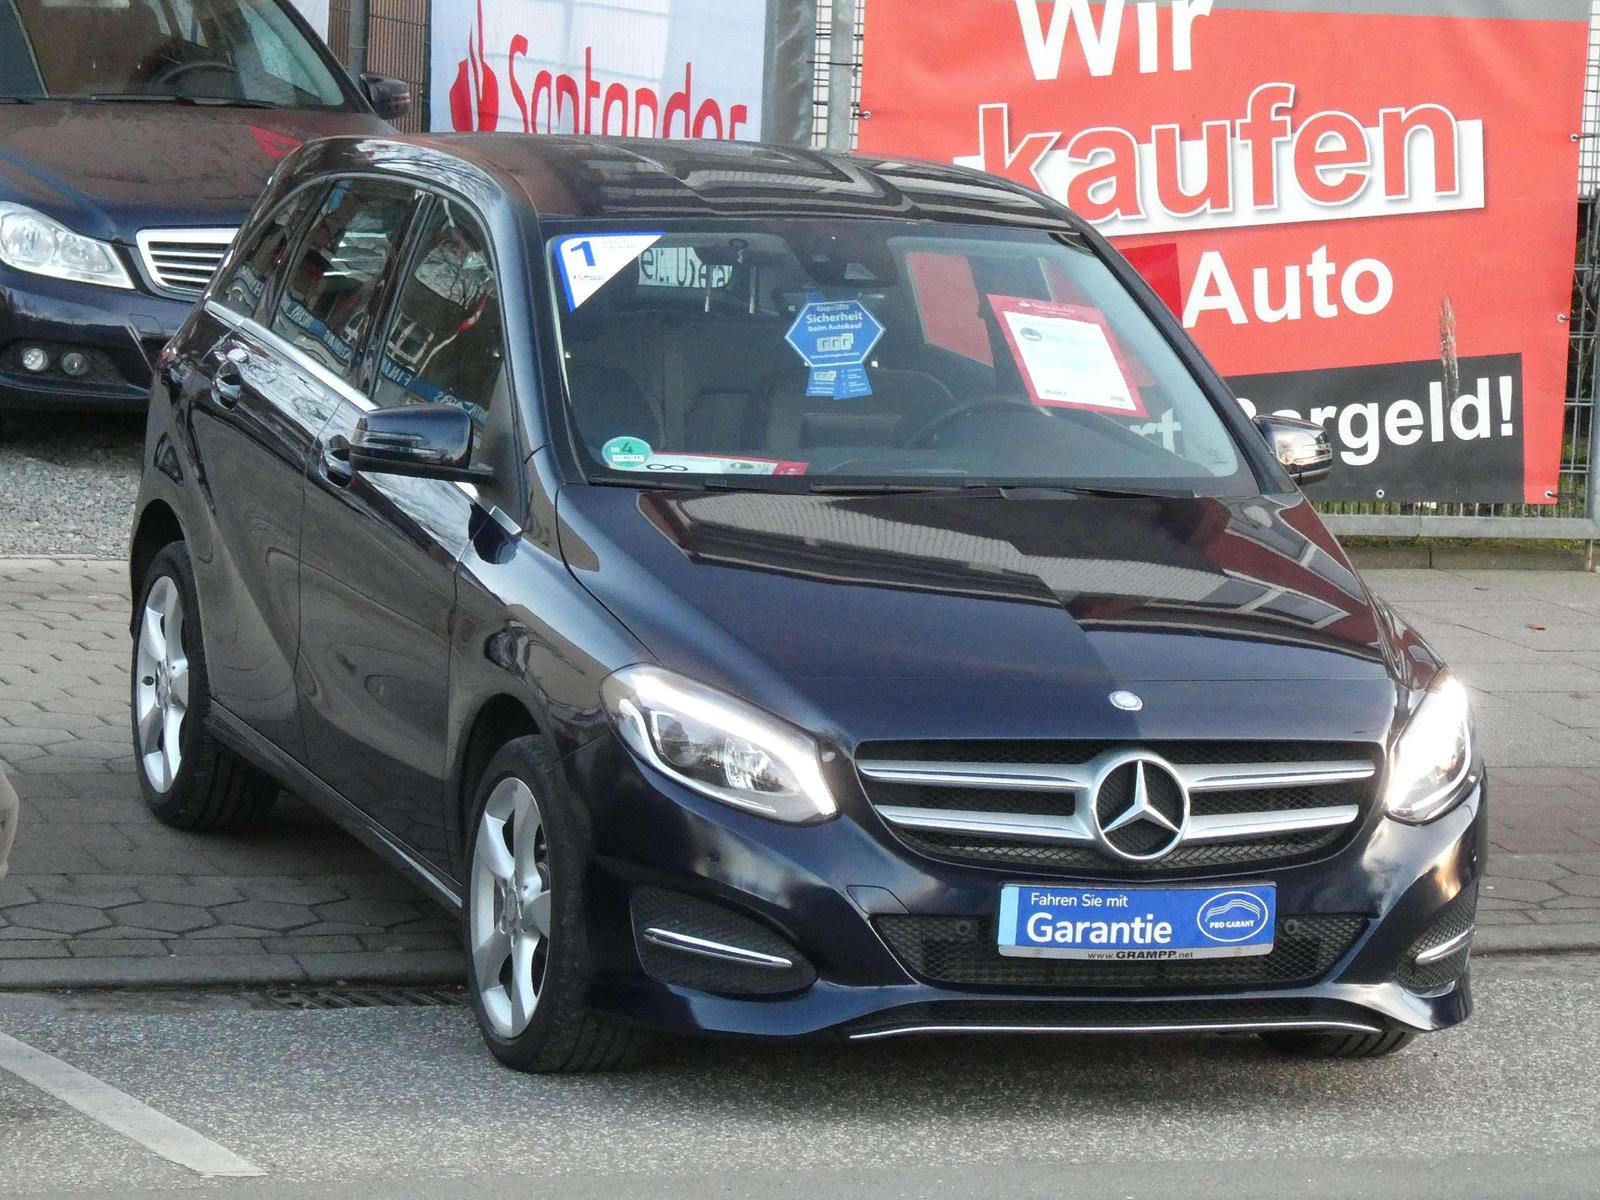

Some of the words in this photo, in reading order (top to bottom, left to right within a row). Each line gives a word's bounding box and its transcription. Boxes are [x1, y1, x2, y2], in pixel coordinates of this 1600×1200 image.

[1017, 0, 1212, 81] Wir
[977, 83, 1463, 224] kaufen
[1182, 245, 1394, 328] Auto
[806, 311, 863, 324] Sicherheit
[1236, 375, 1513, 466] rgeld!
[1031, 892, 1077, 907] Fahren
[1082, 893, 1102, 907] Sie
[1106, 894, 1128, 907] mit
[1026, 912, 1172, 944] Garantie
[1209, 921, 1224, 929] PRO
[1226, 920, 1255, 929] GARANT
[1087, 949, 1193, 960] www.GRAMPP.net
